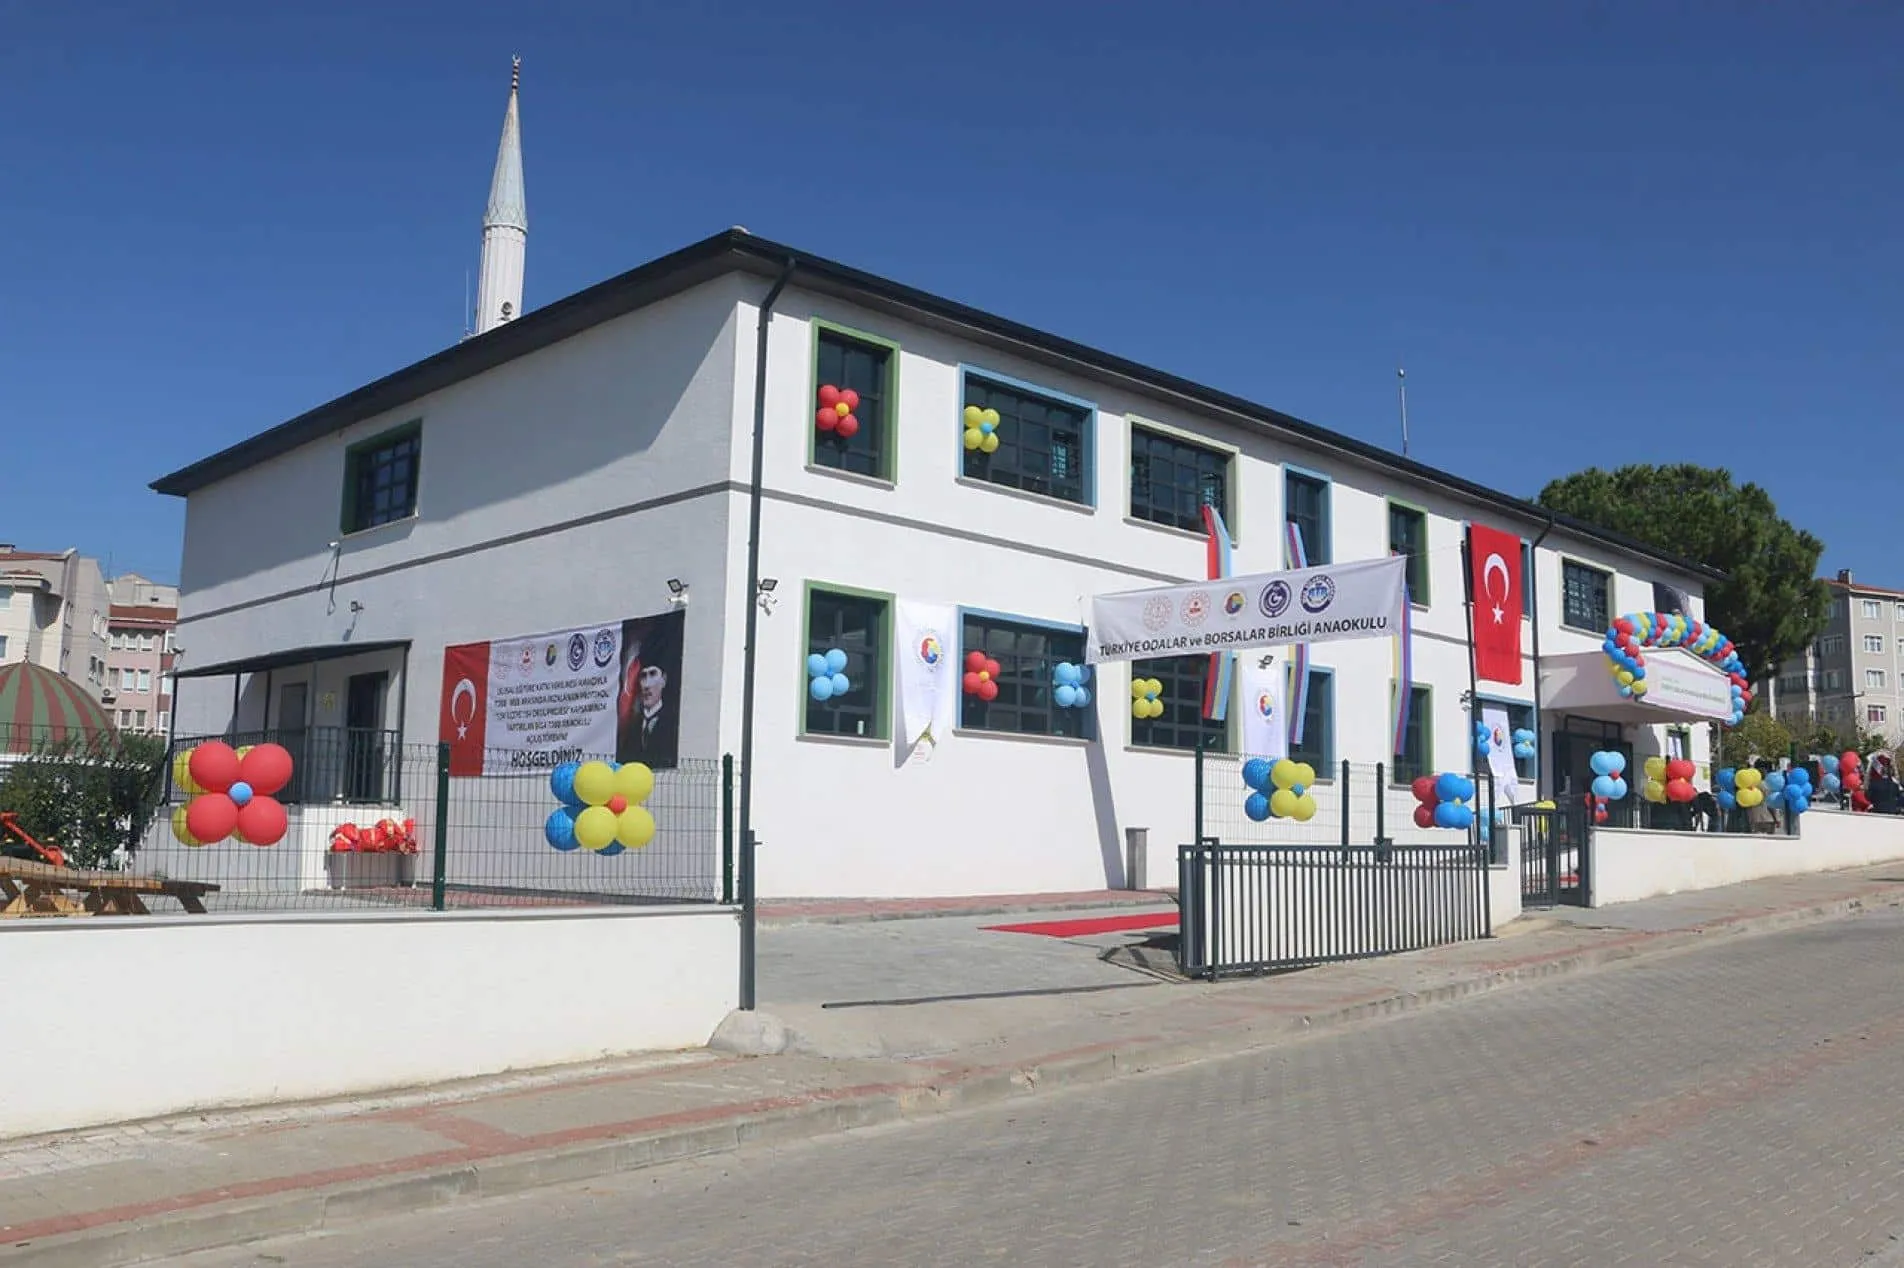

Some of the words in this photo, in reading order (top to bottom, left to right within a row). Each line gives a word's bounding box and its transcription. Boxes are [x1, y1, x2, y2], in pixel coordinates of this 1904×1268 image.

[1142, 637, 1188, 651] ODALAR
[1190, 637, 1202, 646] ve
[1204, 627, 1265, 645] BORSALAR
[1314, 616, 1387, 634] ANAOKULU
